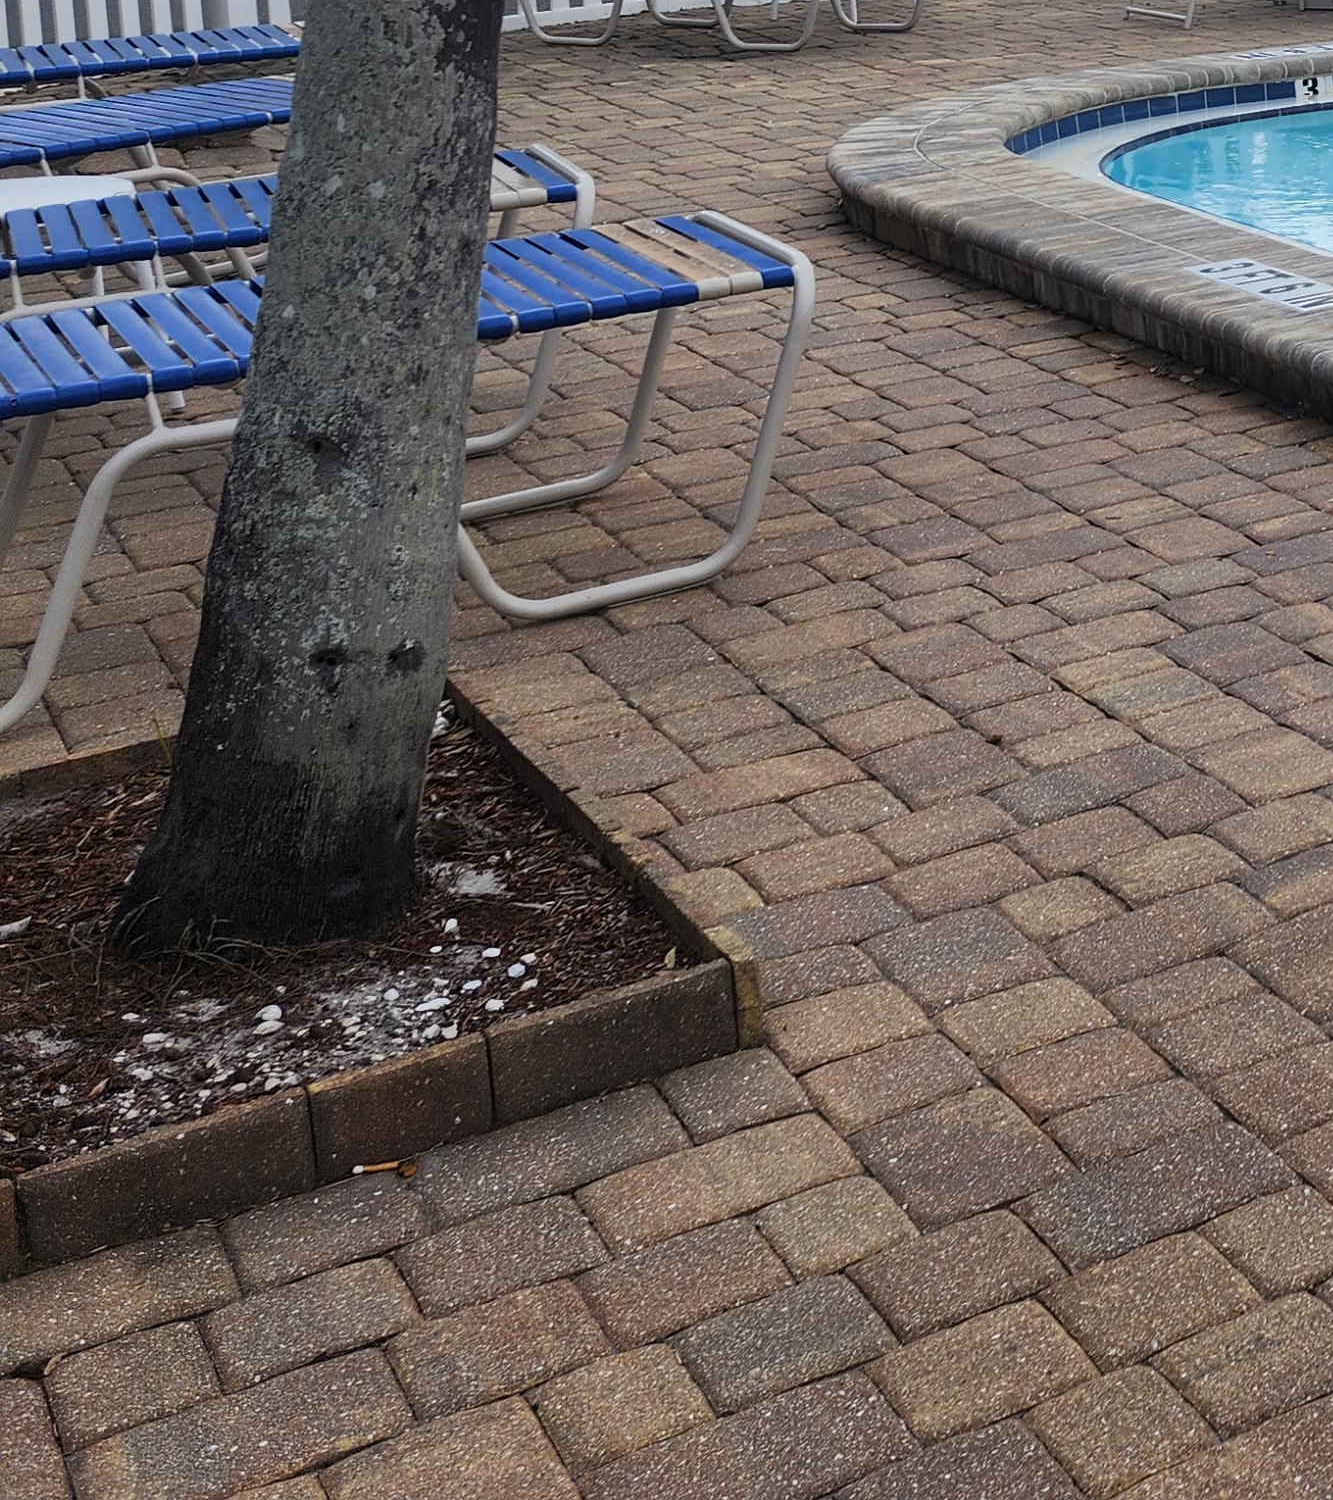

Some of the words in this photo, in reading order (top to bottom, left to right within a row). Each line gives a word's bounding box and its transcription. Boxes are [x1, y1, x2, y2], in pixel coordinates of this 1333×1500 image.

[1302, 77, 1320, 96] 3
[1198, 261, 1256, 274] 3
[1218, 268, 1296, 286] FT
[1258, 281, 1317, 294] 6
